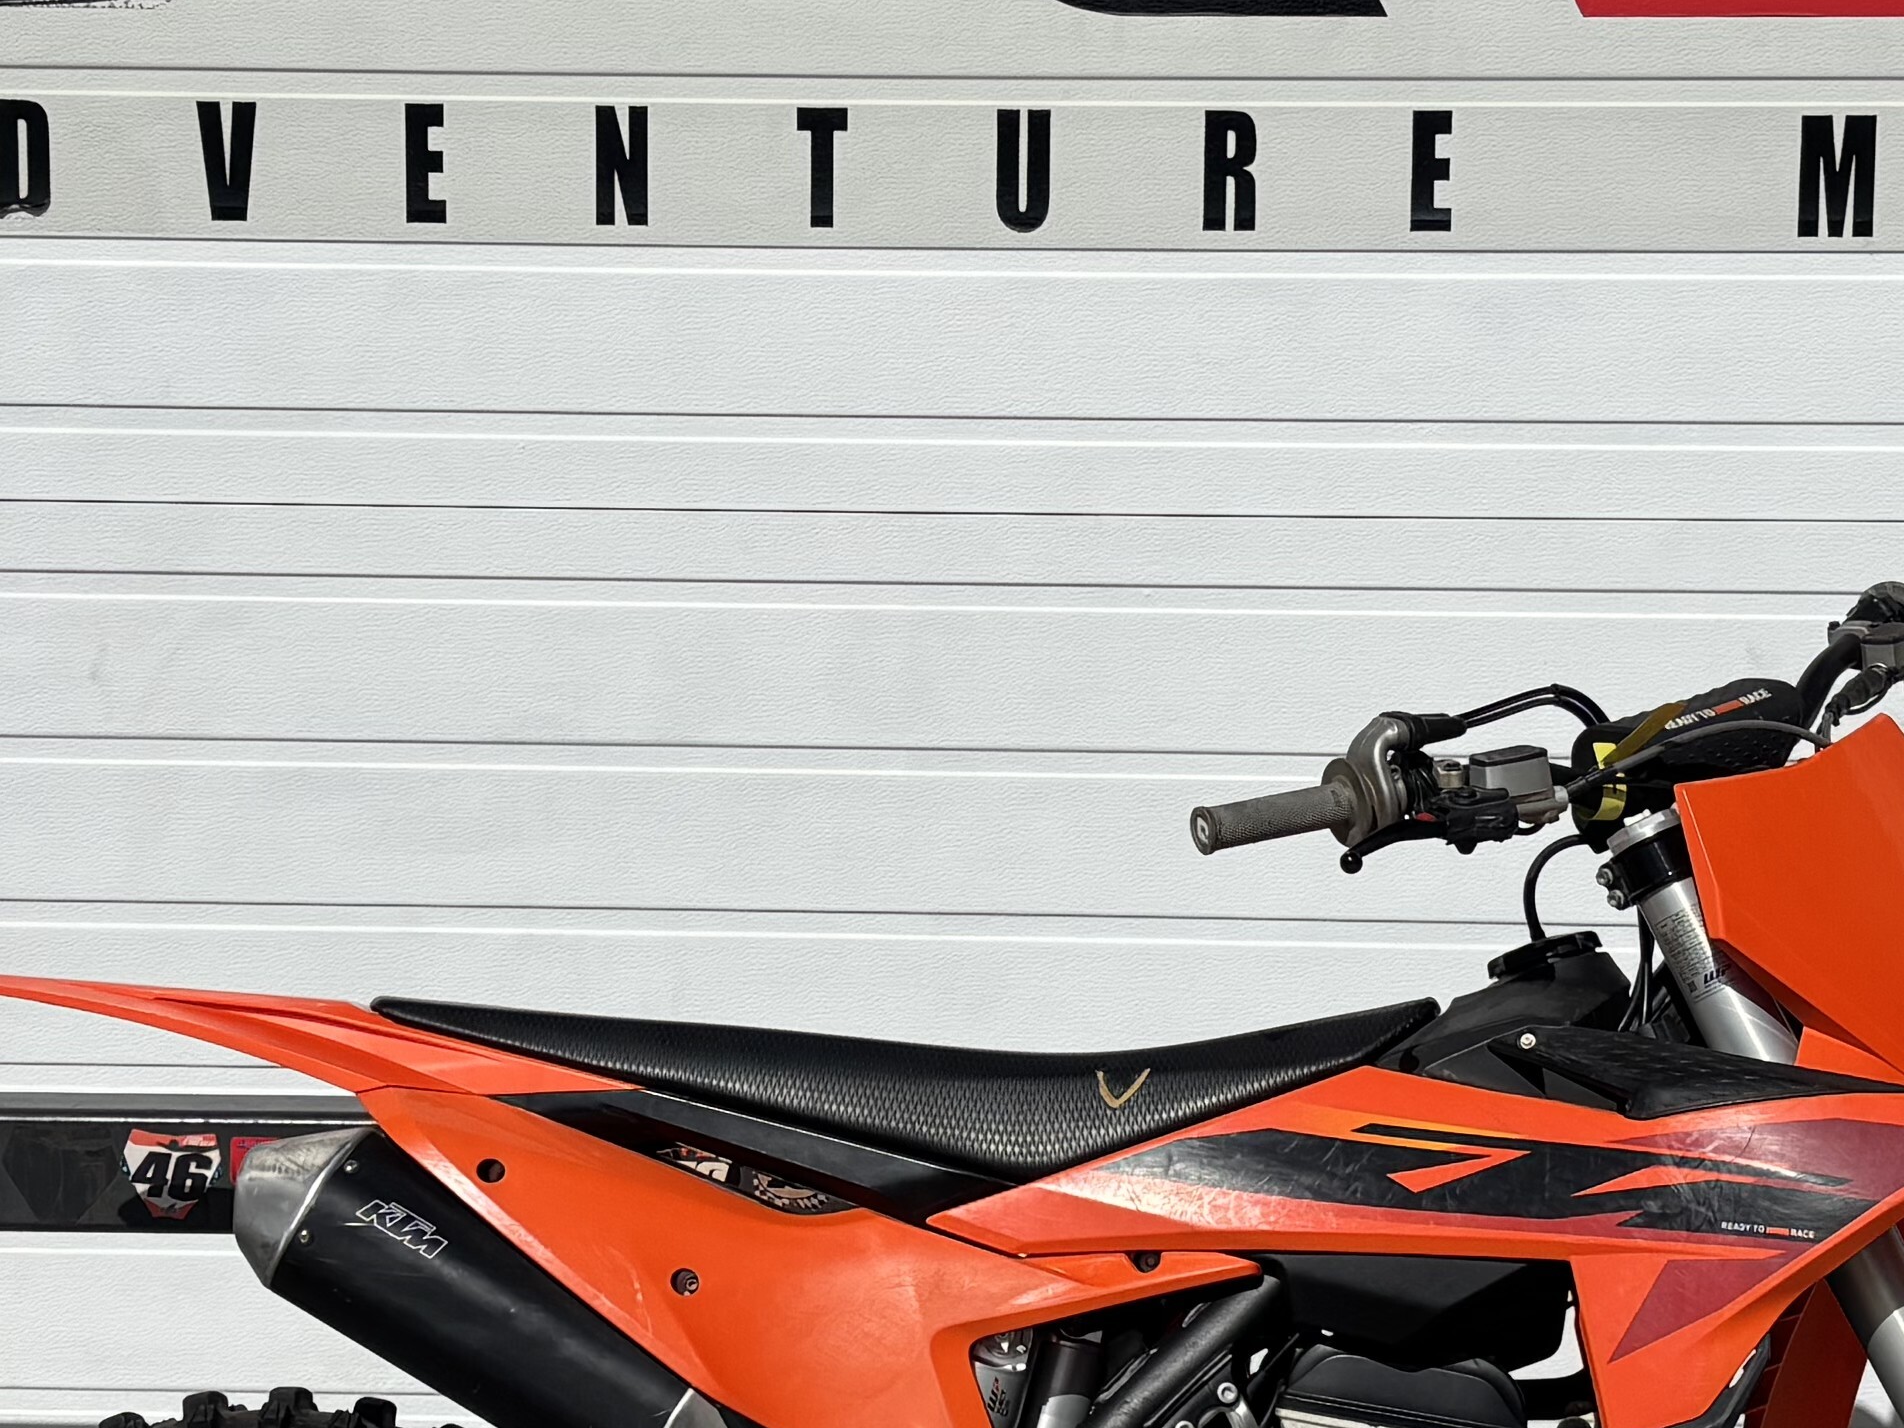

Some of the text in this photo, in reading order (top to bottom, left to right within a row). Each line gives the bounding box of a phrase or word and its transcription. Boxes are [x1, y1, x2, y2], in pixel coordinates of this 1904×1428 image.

[131, 1151, 213, 1202] 46
[355, 1199, 448, 1259] KTM
[1721, 1221, 1816, 1239] READY TO RACE
